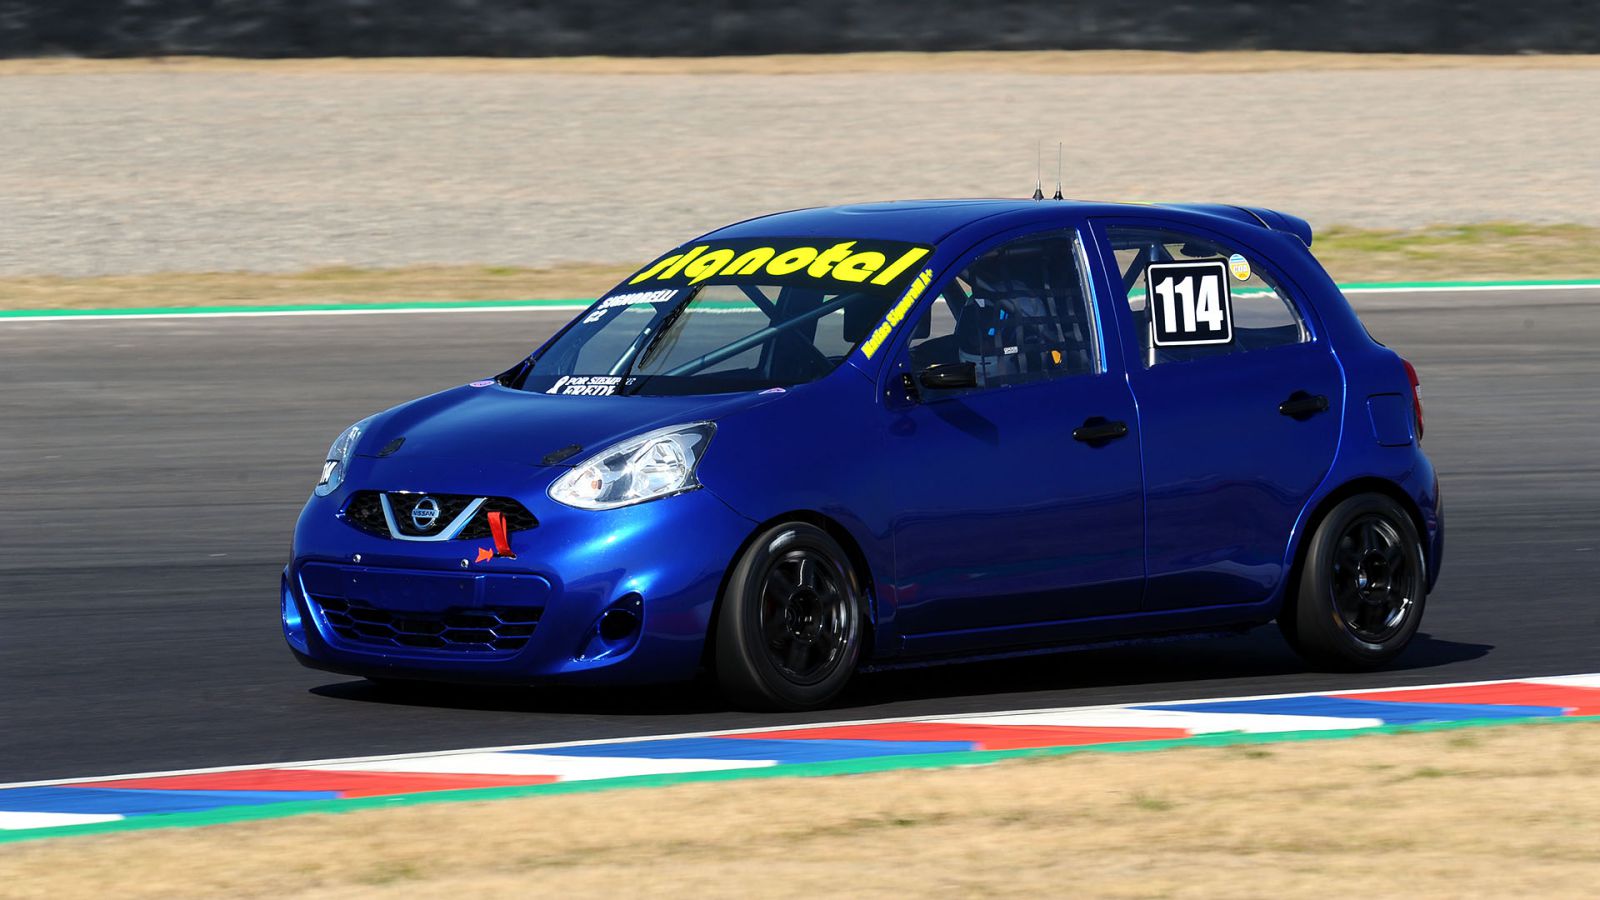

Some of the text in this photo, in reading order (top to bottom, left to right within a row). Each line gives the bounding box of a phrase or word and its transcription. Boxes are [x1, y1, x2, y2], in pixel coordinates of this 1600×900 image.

[1155, 275, 1224, 333] 114
[564, 376, 637, 386] POR SIEMPE
